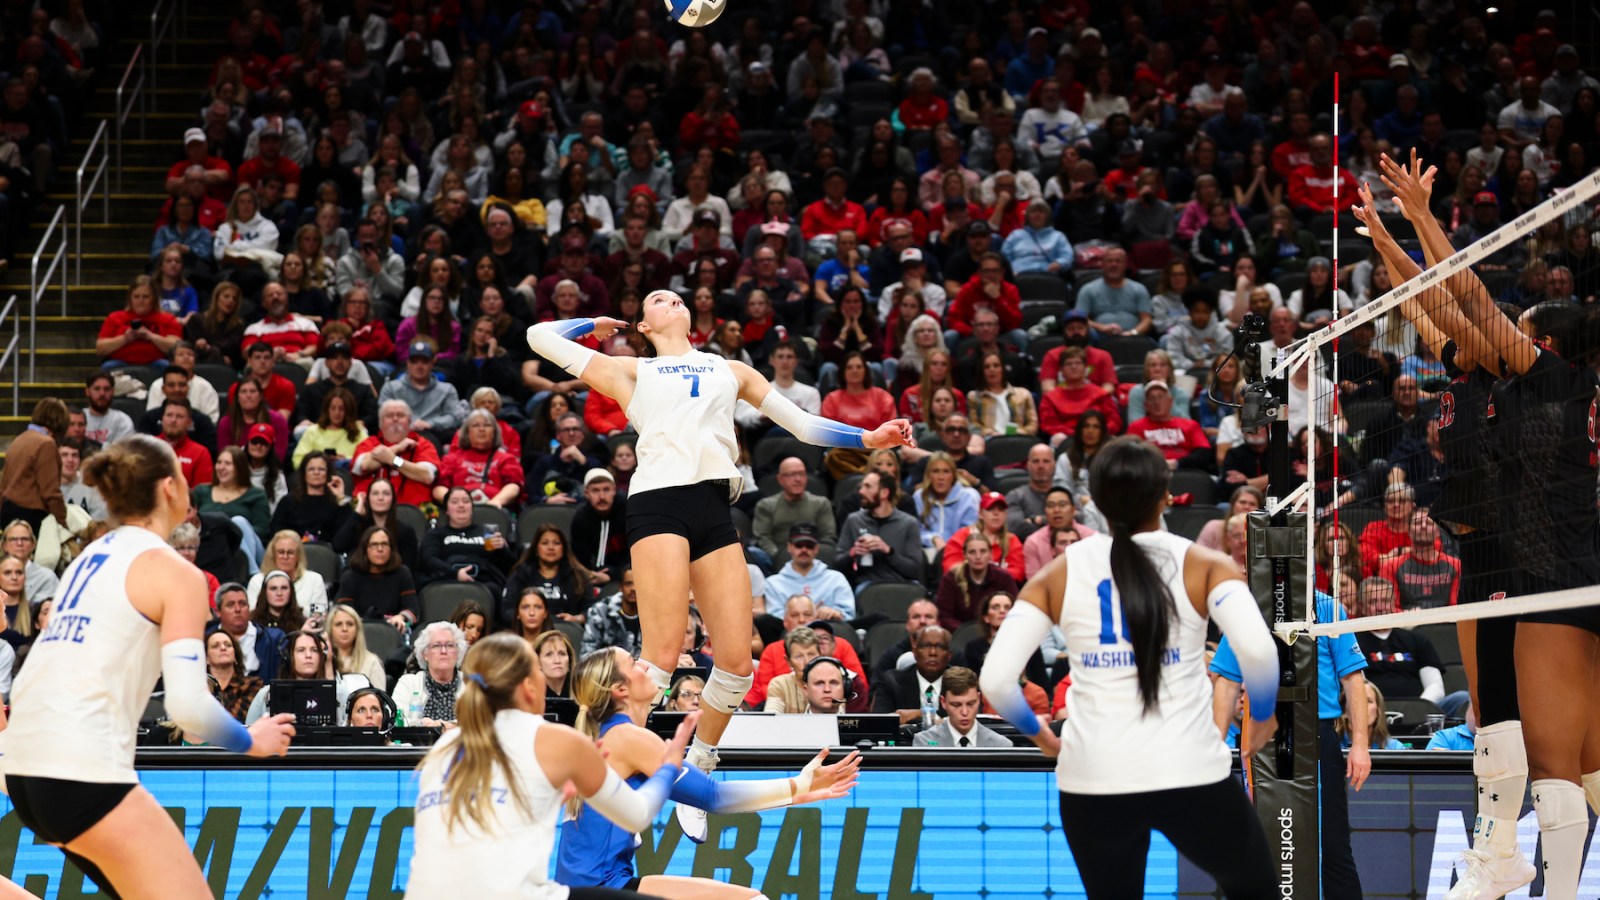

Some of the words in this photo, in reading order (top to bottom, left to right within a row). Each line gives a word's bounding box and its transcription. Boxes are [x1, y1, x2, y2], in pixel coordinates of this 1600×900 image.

[1033, 122, 1072, 144] K
[657, 365, 715, 374] KENTUCKY
[682, 374, 700, 398] 7
[57, 553, 110, 612] 17
[1096, 578, 1132, 645] 1
[1081, 647, 1181, 668] WASHINON
[1277, 807, 1296, 861] sports
[1278, 863, 1295, 900] imp
